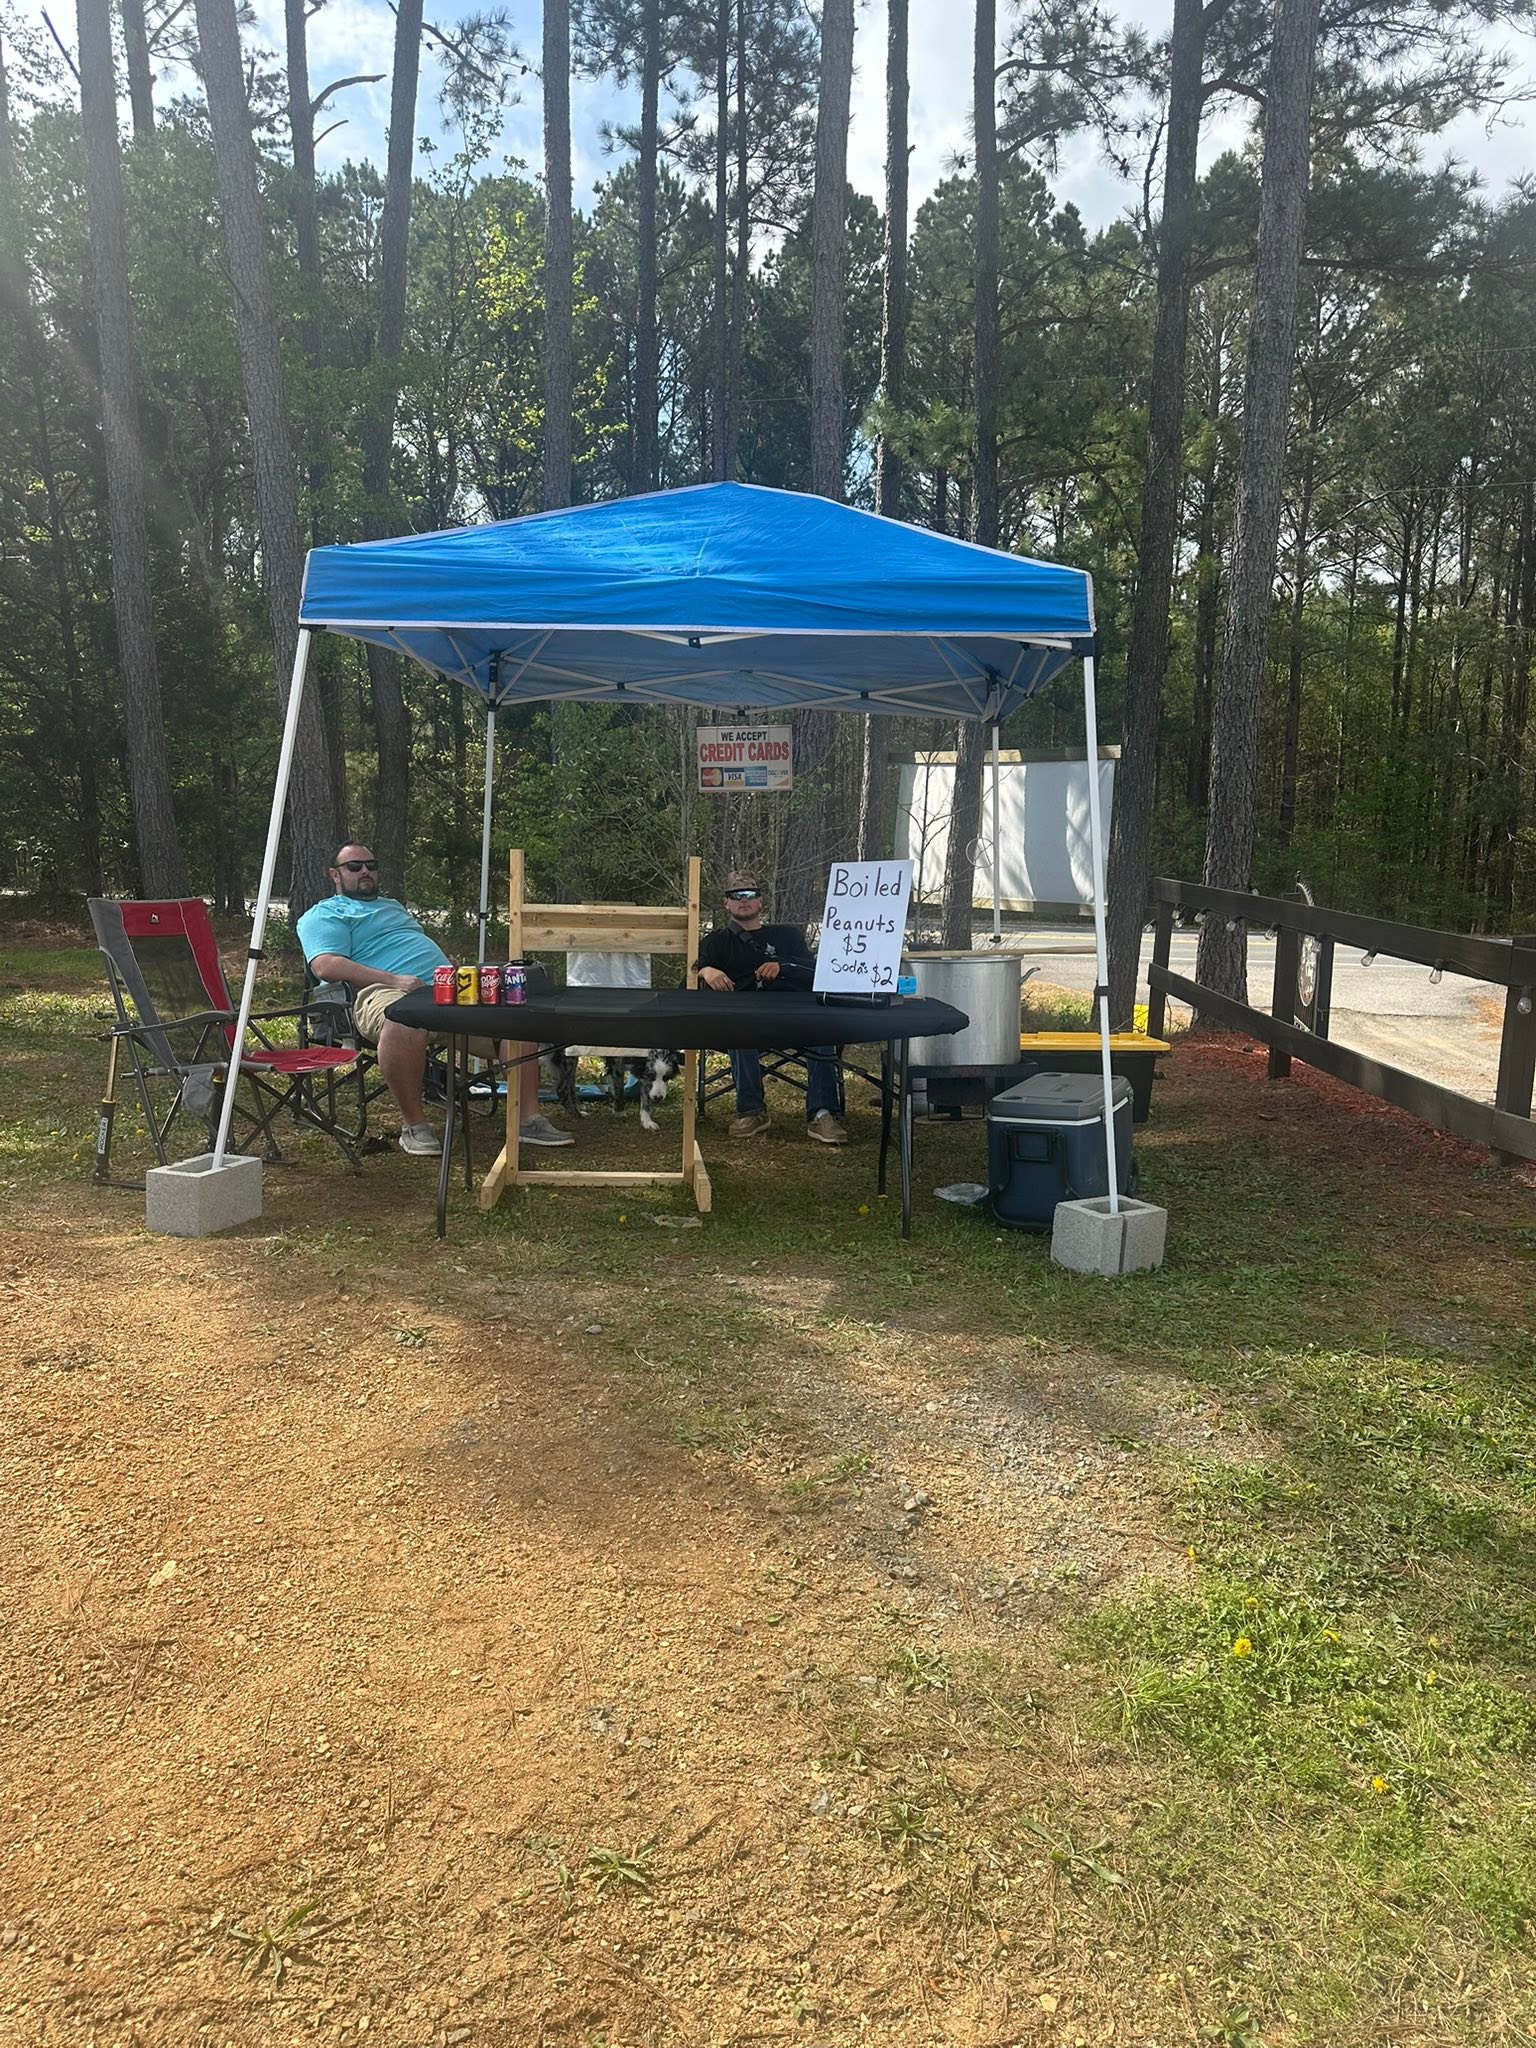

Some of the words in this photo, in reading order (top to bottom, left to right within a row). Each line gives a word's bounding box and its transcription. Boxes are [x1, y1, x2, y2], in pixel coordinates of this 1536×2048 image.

[721, 732, 734, 741] WE
[736, 731, 767, 741] ACCEPT
[700, 743, 745, 762] CREDIT
[748, 741, 789, 761] CARDS
[728, 773, 742, 781] VISA
[833, 867, 902, 897] Boiled
[826, 906, 895, 933] Peanuts
[843, 933, 867, 955] $5
[870, 963, 893, 988] $2
